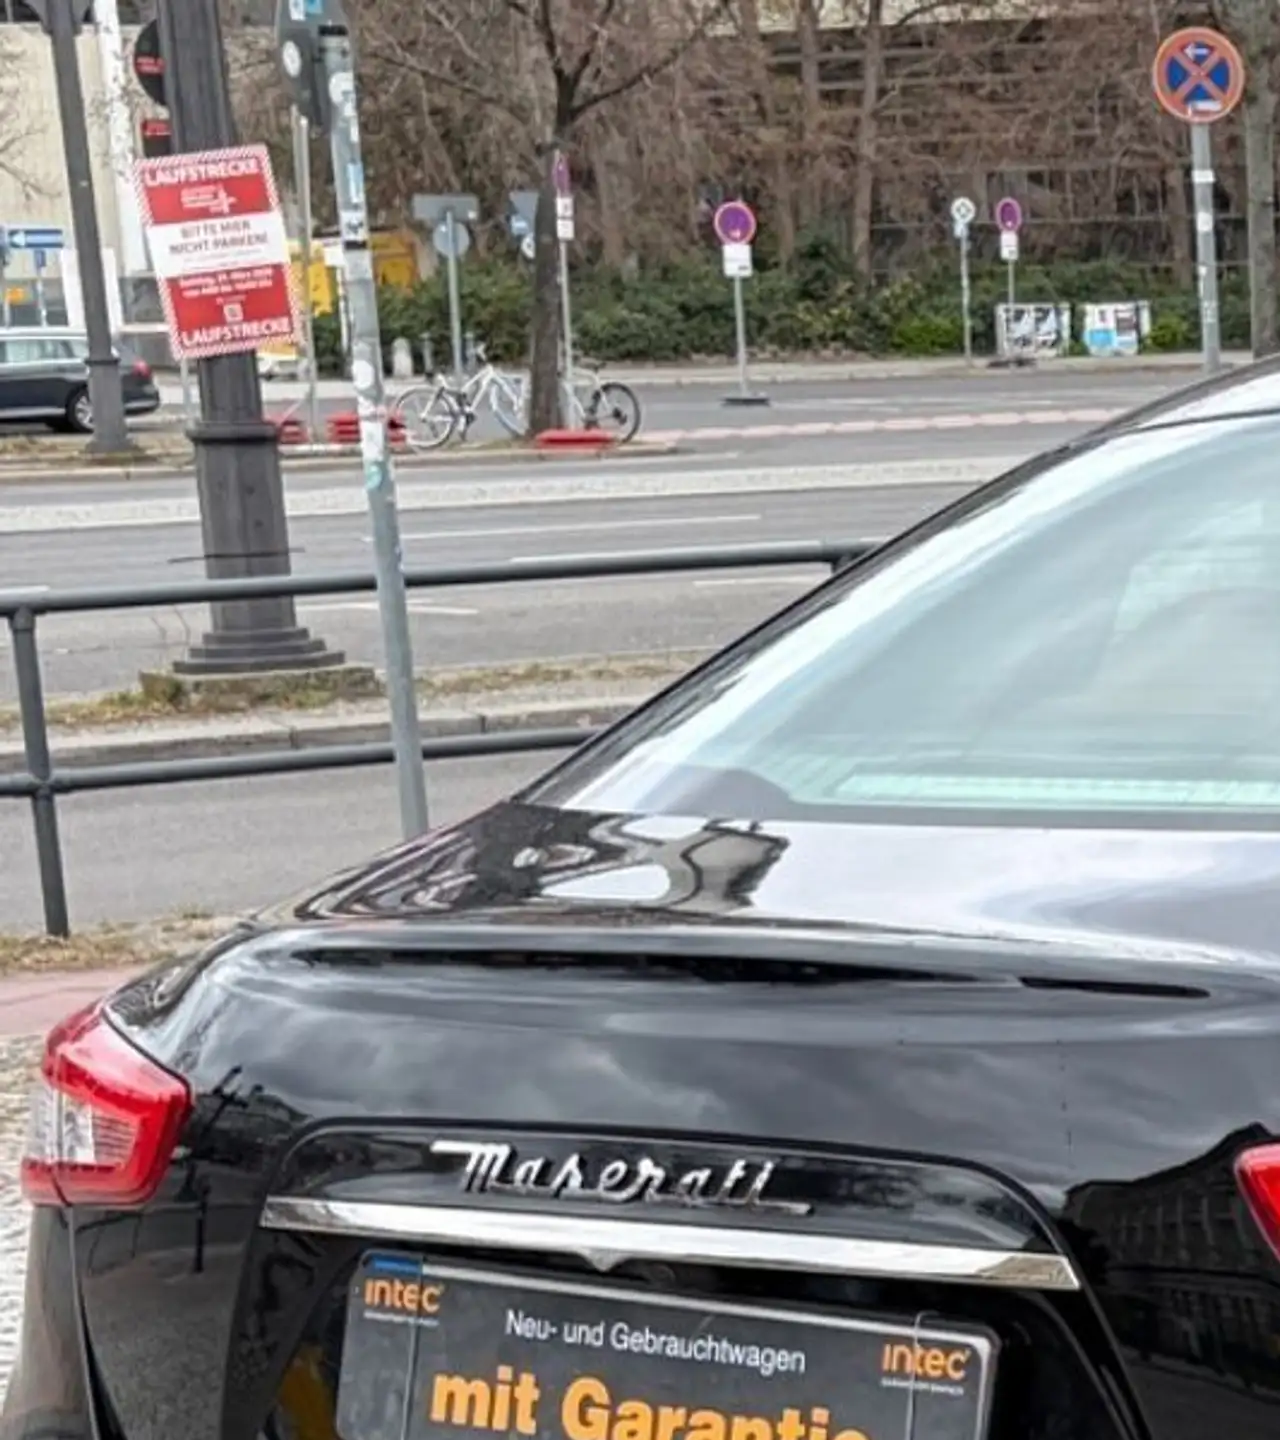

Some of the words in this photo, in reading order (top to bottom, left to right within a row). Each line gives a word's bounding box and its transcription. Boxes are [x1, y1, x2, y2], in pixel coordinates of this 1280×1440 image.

[144, 158, 260, 187] LAUFSTRECKE
[181, 316, 291, 347] LAUFSTRECKE
[430, 1140, 815, 1215] Maserati
[363, 1278, 442, 1314] intec
[505, 1309, 558, 1341] Neu-
[563, 1320, 604, 1347] und
[610, 1322, 806, 1376] Gebrauchtwagen
[882, 1343, 967, 1381] intec
[430, 1365, 541, 1435] mit
